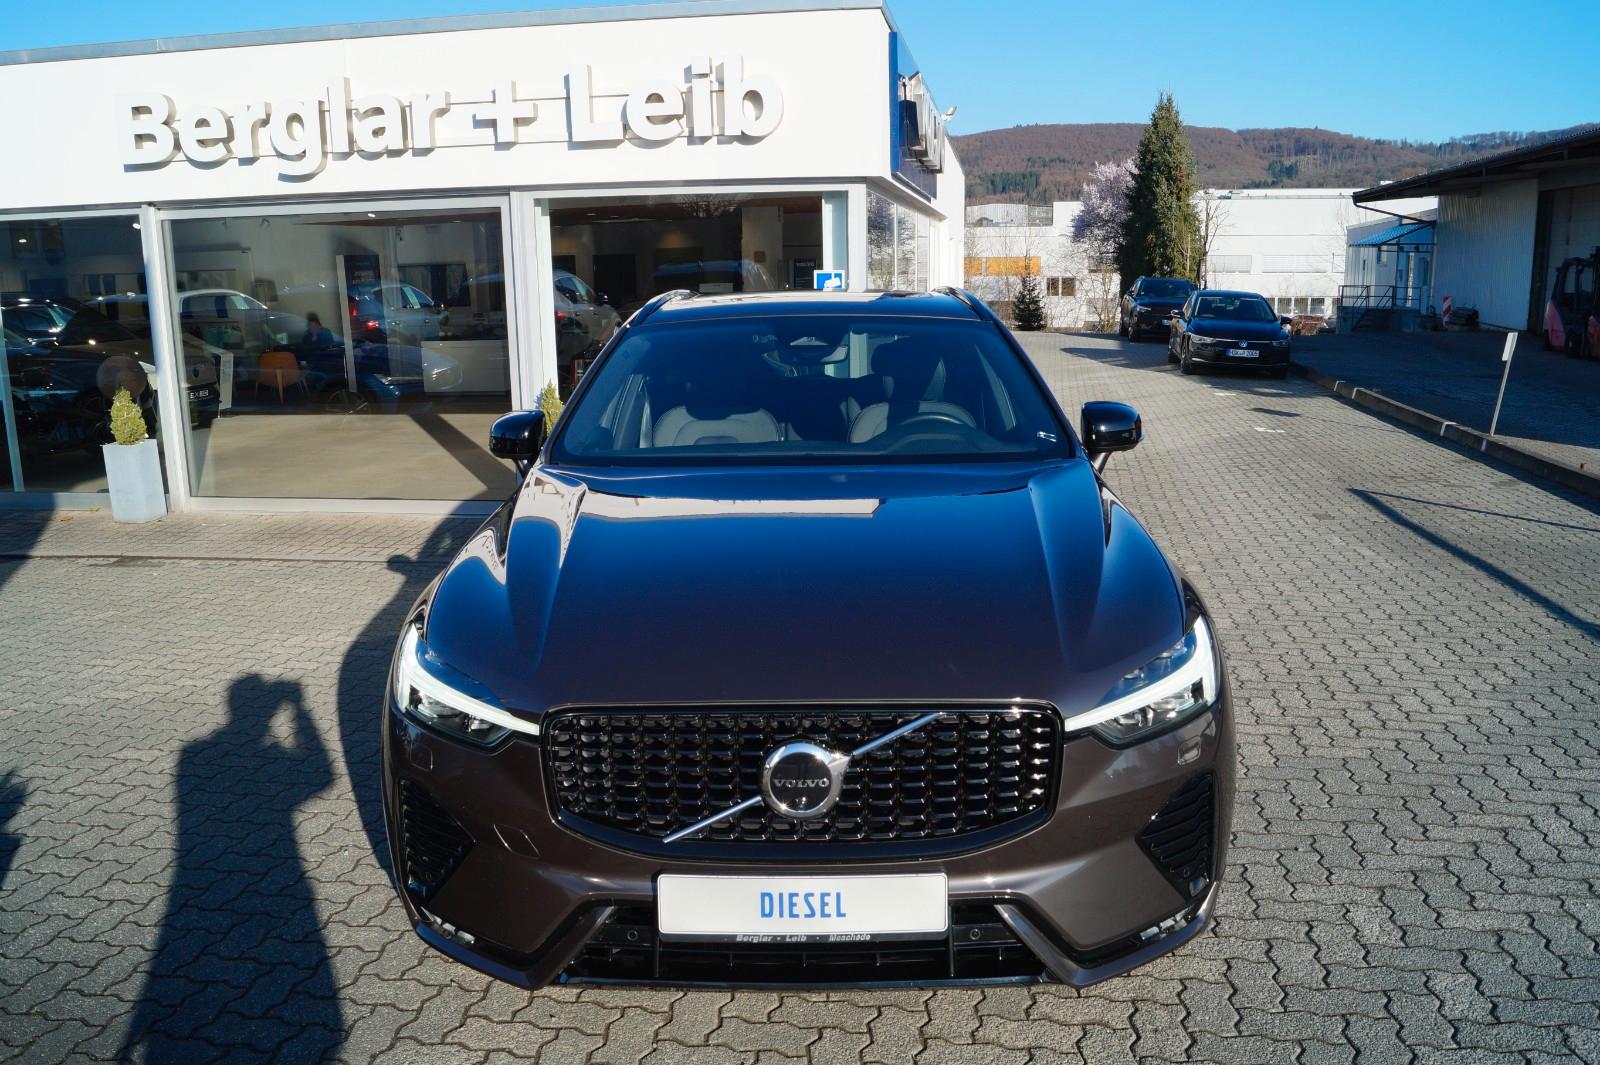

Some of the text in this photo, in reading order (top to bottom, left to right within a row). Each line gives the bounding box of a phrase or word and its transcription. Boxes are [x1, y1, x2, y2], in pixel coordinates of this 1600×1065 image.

[118, 55, 785, 182] Berglar + Leib
[772, 778, 830, 788] VOLVO
[760, 891, 847, 919] DIESEL
